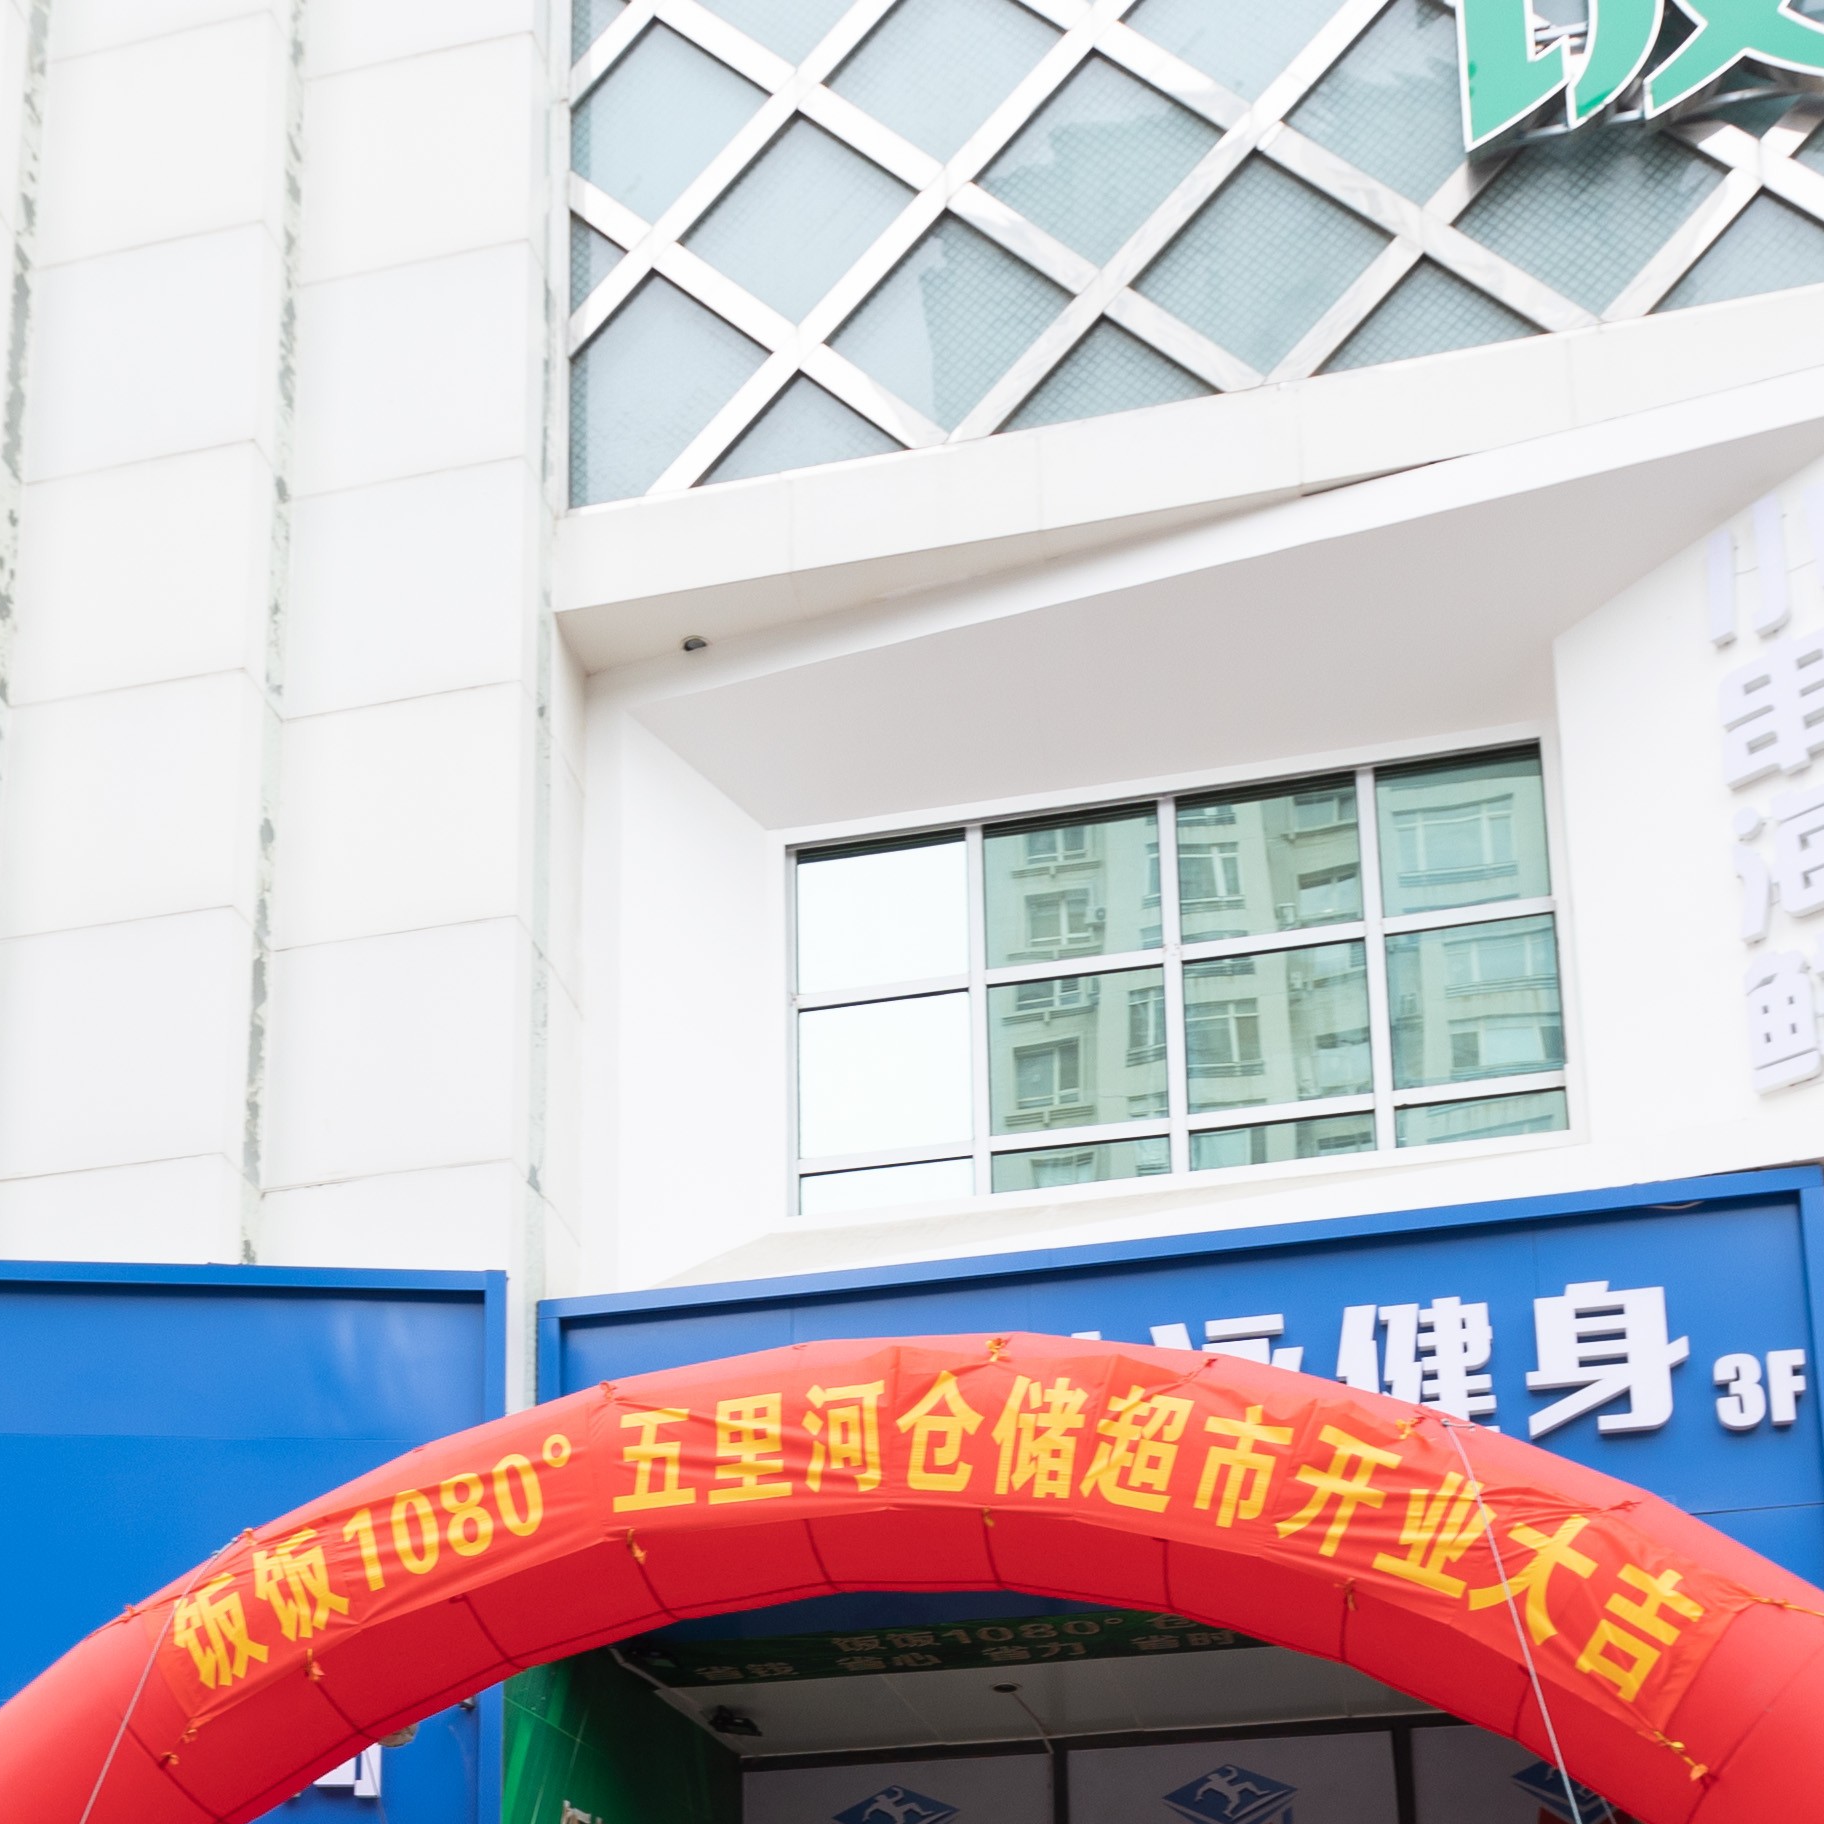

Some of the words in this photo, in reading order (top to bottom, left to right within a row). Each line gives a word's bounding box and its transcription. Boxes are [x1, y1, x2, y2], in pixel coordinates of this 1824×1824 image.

[1712, 1348, 1806, 1431] 3F
[613, 1369, 1704, 1701] 五里河仓储超市开业大吉
